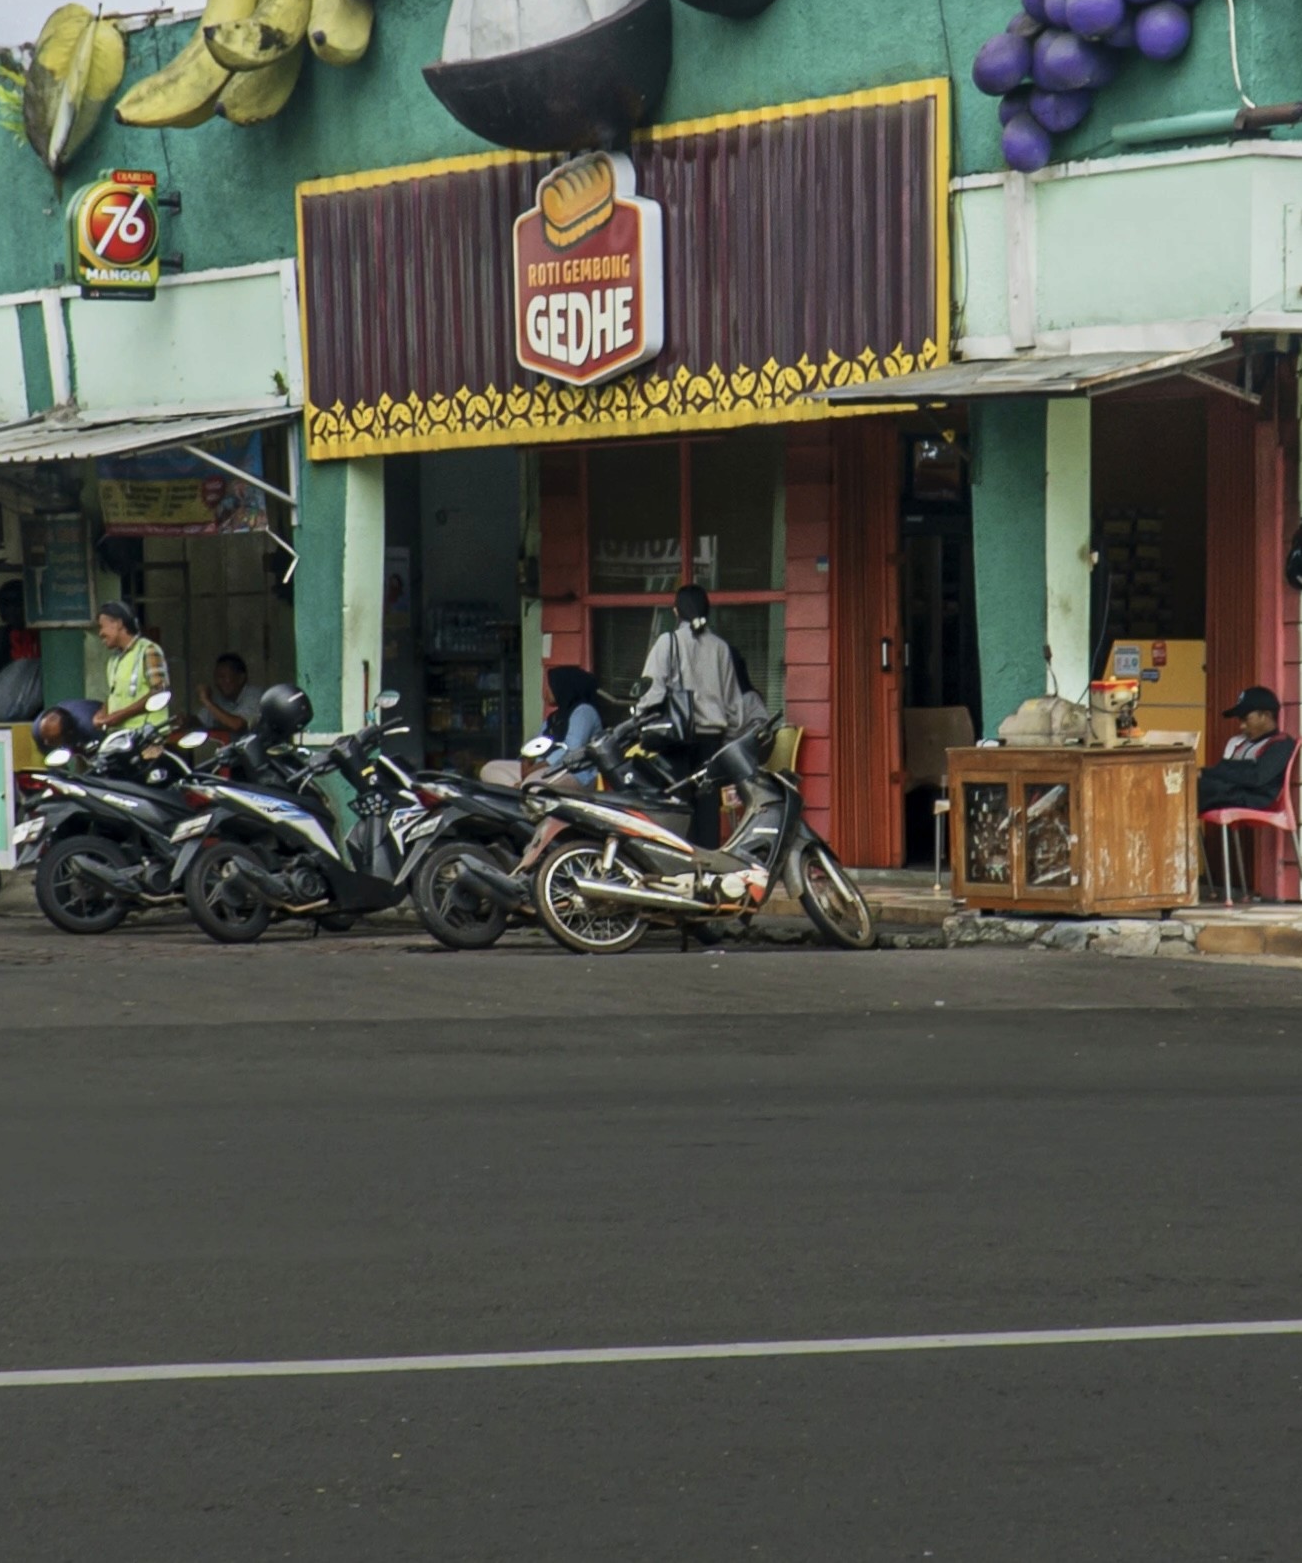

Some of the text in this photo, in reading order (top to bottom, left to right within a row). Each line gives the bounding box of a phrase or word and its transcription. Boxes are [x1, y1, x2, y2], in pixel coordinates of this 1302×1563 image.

[95, 192, 146, 257] 76
[85, 267, 152, 284] MANGGA
[527, 254, 631, 288] ROTI GEMBONG
[526, 286, 634, 367] GEDHE
